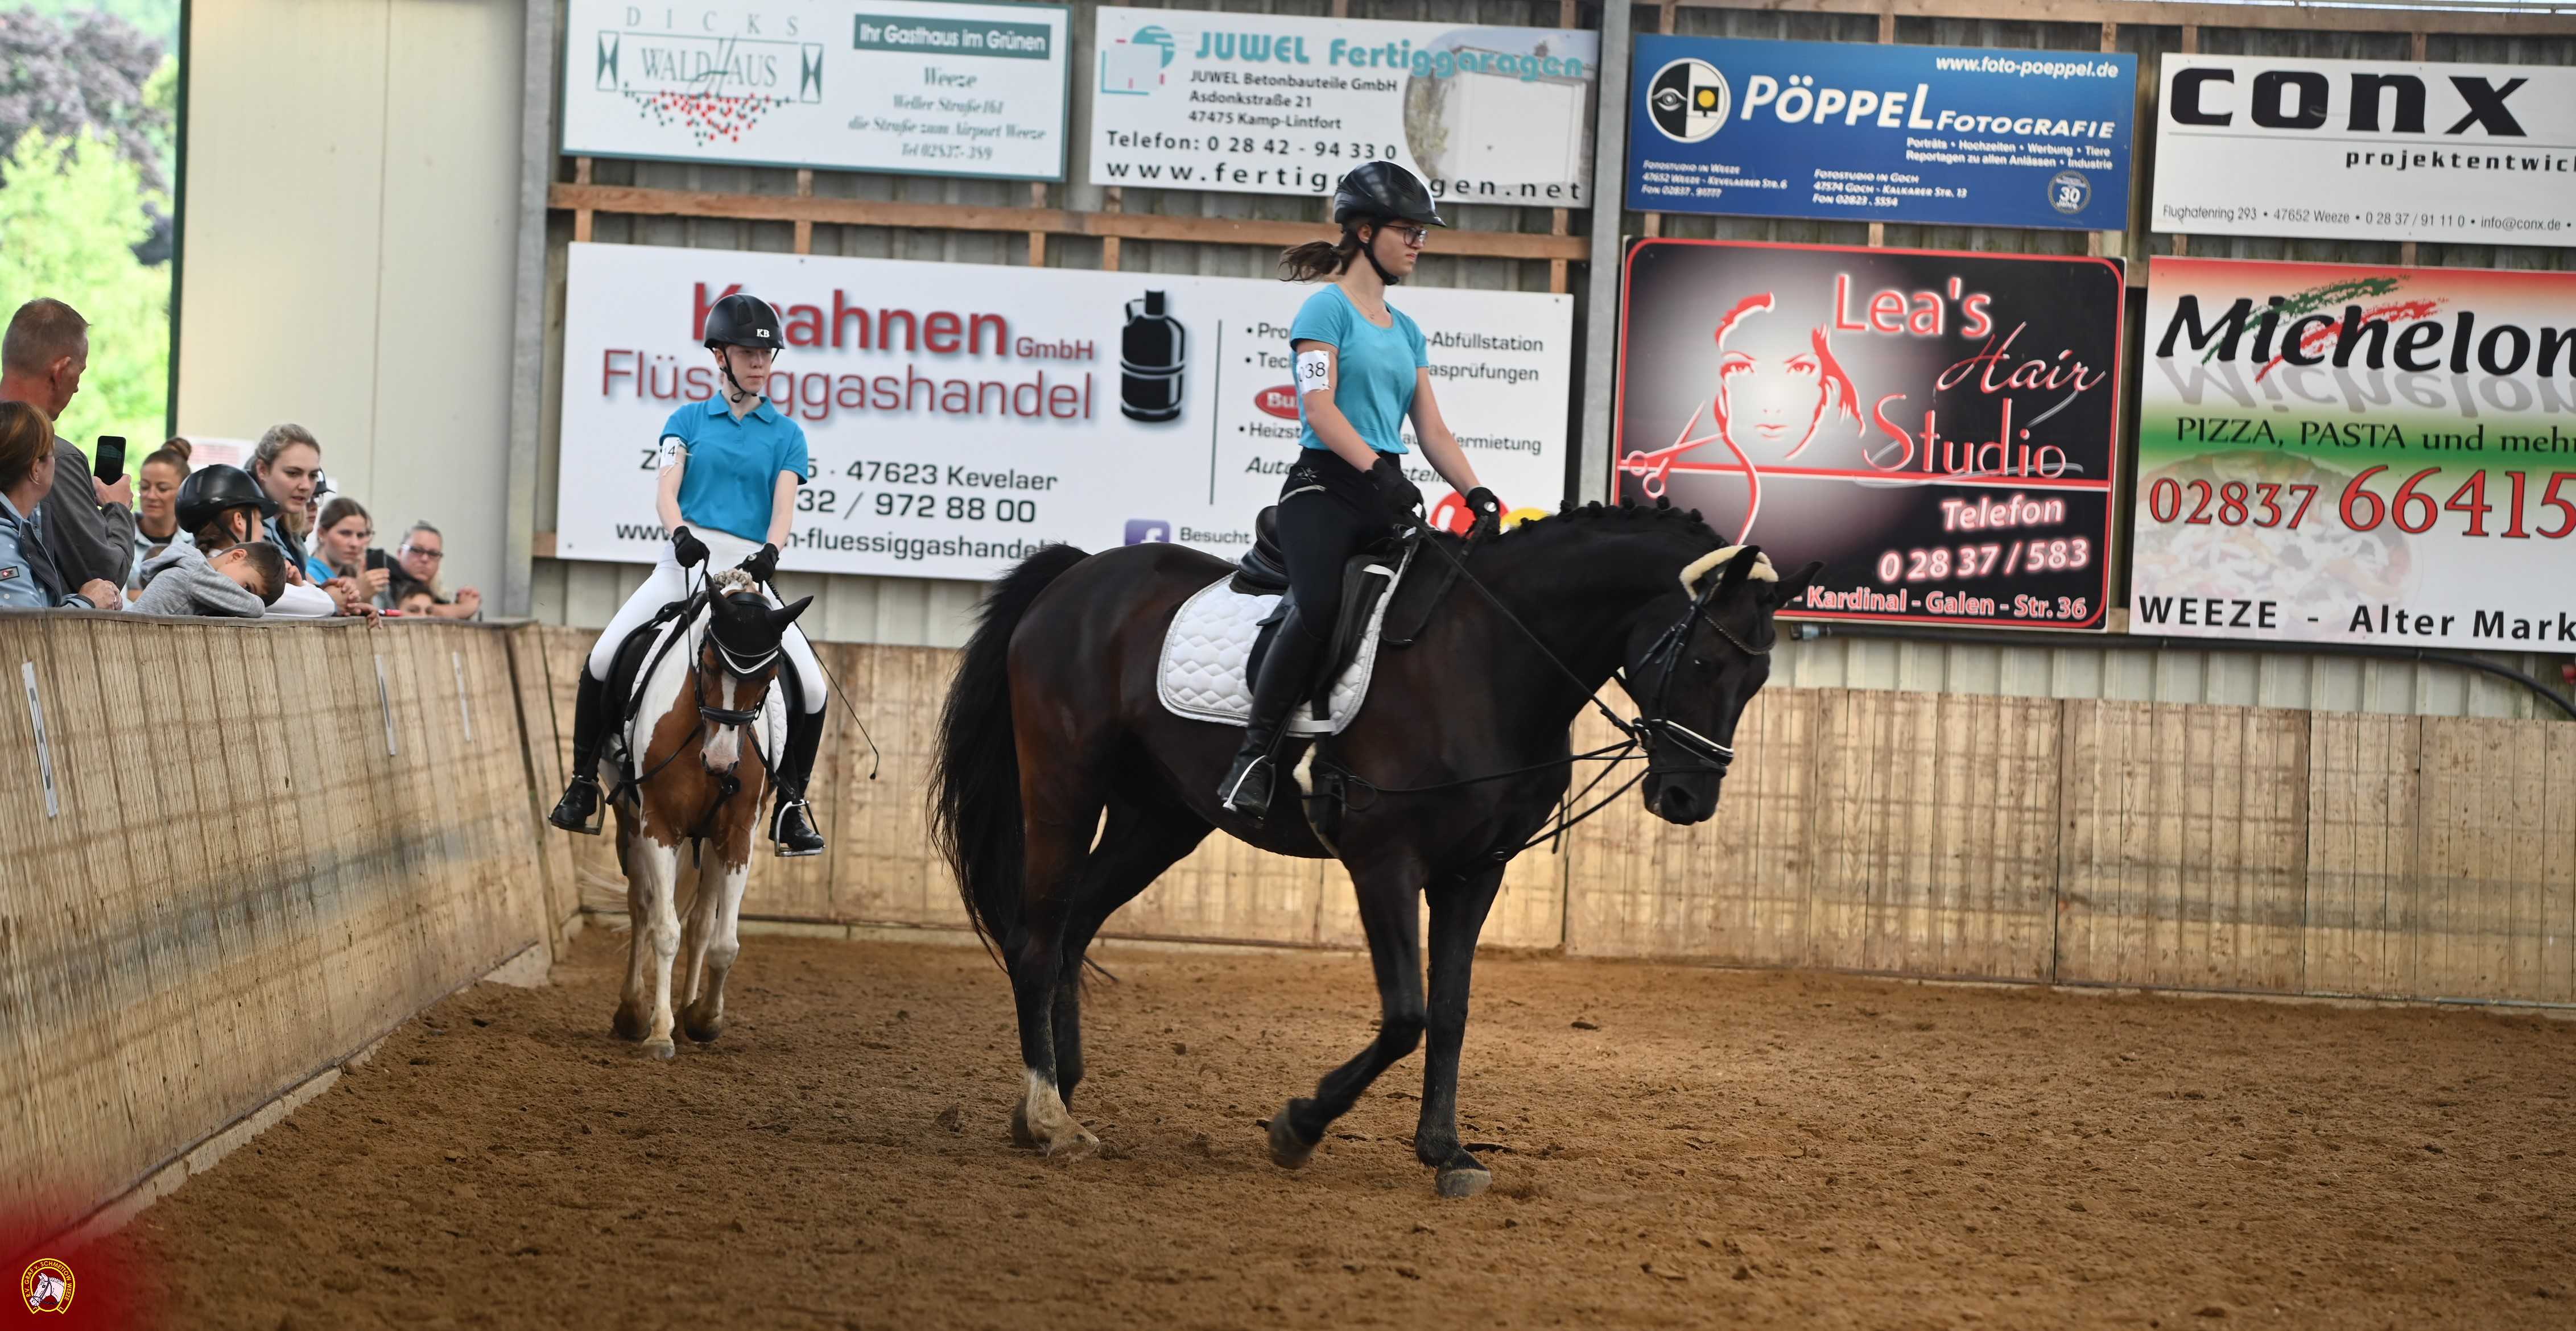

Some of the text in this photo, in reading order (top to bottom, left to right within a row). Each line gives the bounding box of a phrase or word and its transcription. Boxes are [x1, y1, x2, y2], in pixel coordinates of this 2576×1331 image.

[860, 23, 1046, 52] Ihr Gasthaus im Grünen
[1195, 31, 1584, 81] JUWEL Fertiggaragen
[1936, 56, 2119, 78] www.foto-poeppel.de
[924, 67, 977, 88] Weeze
[1190, 70, 1398, 92] JUWEL Betonbauteile GmbH
[1189, 89, 1312, 108] Asdonkstraße 21
[2170, 67, 2529, 138] conx
[848, 115, 1047, 140] die Straße zum Airport Weeze
[1188, 110, 1343, 130] 47475 Kamp-Lintfort
[1107, 130, 1199, 151] Telefon:
[1207, 136, 1220, 152] 0
[1229, 137, 1255, 154] 28
[1264, 139, 1290, 155] 42
[1315, 142, 1341, 158] 94
[1350, 143, 1375, 160] 33
[1385, 144, 1397, 160] 0
[1907, 137, 2111, 156] Porträts Hochzeiten Werbung Tiere
[1906, 150, 2113, 170] Reportagen zu allen Anlässen Industrie
[2059, 186, 2080, 204] 30
[2163, 204, 2234, 222] Flughafenring
[2238, 206, 2257, 221] 293
[2273, 208, 2310, 223] 47652
[2314, 210, 2350, 224] Weeze
[2366, 212, 2373, 225] 0
[2377, 212, 2391, 226] 28
[2395, 212, 2409, 226] 37
[2421, 213, 2434, 226] 91
[2440, 214, 2453, 227] 11
[2458, 214, 2465, 228] 0
[2481, 215, 2561, 232] info@conx.de
[1834, 272, 1993, 339] Lea's
[693, 282, 1093, 360] Kahnen GmbH
[756, 328, 770, 338] KB
[1427, 330, 1543, 352] -Abfüllstation
[1935, 321, 2106, 394] Hair
[1429, 362, 1539, 385] asprüfungen
[1249, 421, 1542, 456] Heizst ermietung
[1861, 394, 2066, 480] Studio
[2177, 416, 2285, 447] PIZZA,
[2300, 420, 2406, 449] PASTA
[2422, 424, 2484, 452] und
[847, 461, 938, 485] 47623
[947, 465, 1058, 490] Kevelaer
[876, 492, 935, 518] 972
[947, 497, 985, 520] 88
[996, 499, 1036, 523] 00
[1942, 494, 2064, 532] Telefon
[2149, 464, 2576, 539] 02837 66415
[1180, 526, 1251, 544] Besucht
[1880, 551, 1901, 582] 0
[1907, 549, 1950, 580] 28
[1958, 544, 2000, 577] 37
[2026, 538, 2090, 571] 583
[1807, 585, 1907, 613] Kardinal
[1926, 591, 1995, 616] Galen
[2014, 593, 2053, 619] Str.
[2057, 596, 2088, 620] 36
[2139, 595, 2277, 629] WEEZE
[2349, 604, 2455, 637] Alter
